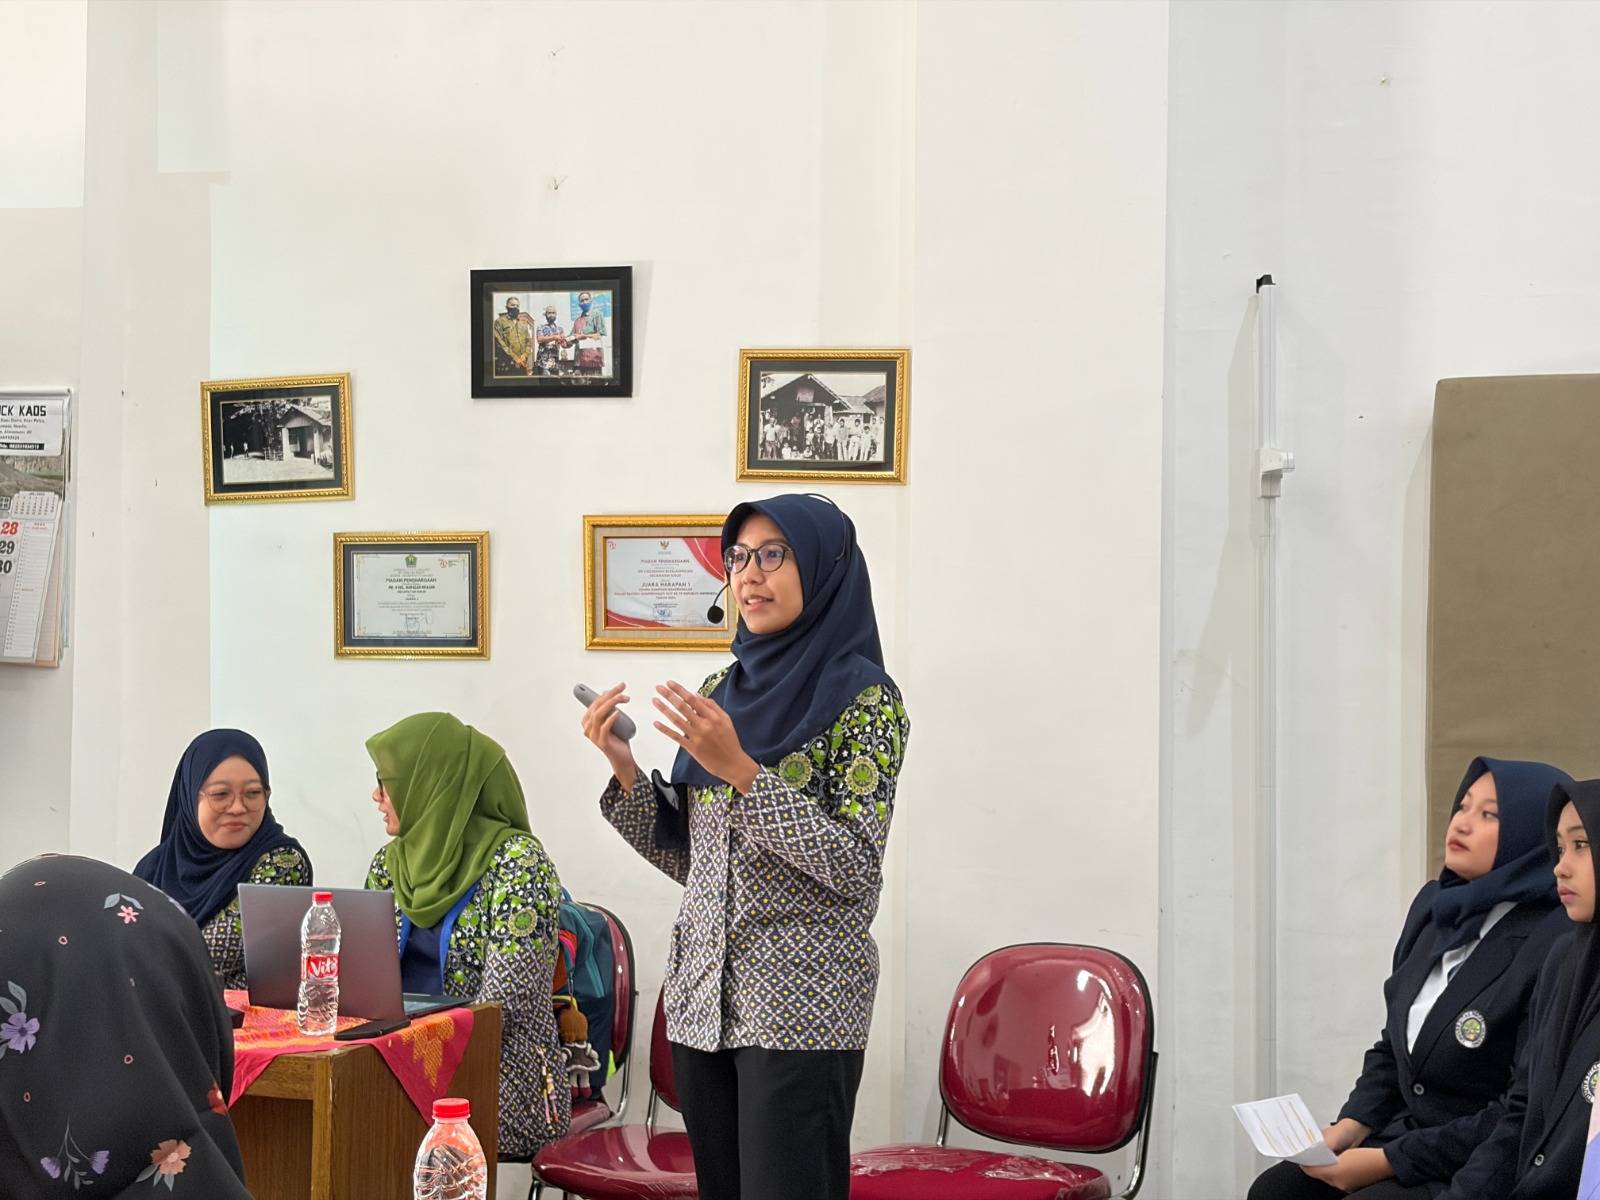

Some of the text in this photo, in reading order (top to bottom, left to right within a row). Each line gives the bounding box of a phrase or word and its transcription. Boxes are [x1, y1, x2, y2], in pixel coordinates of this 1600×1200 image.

[19, 405, 47, 416] KAOS
[1, 521, 19, 535] 28
[0, 540, 15, 554] 29
